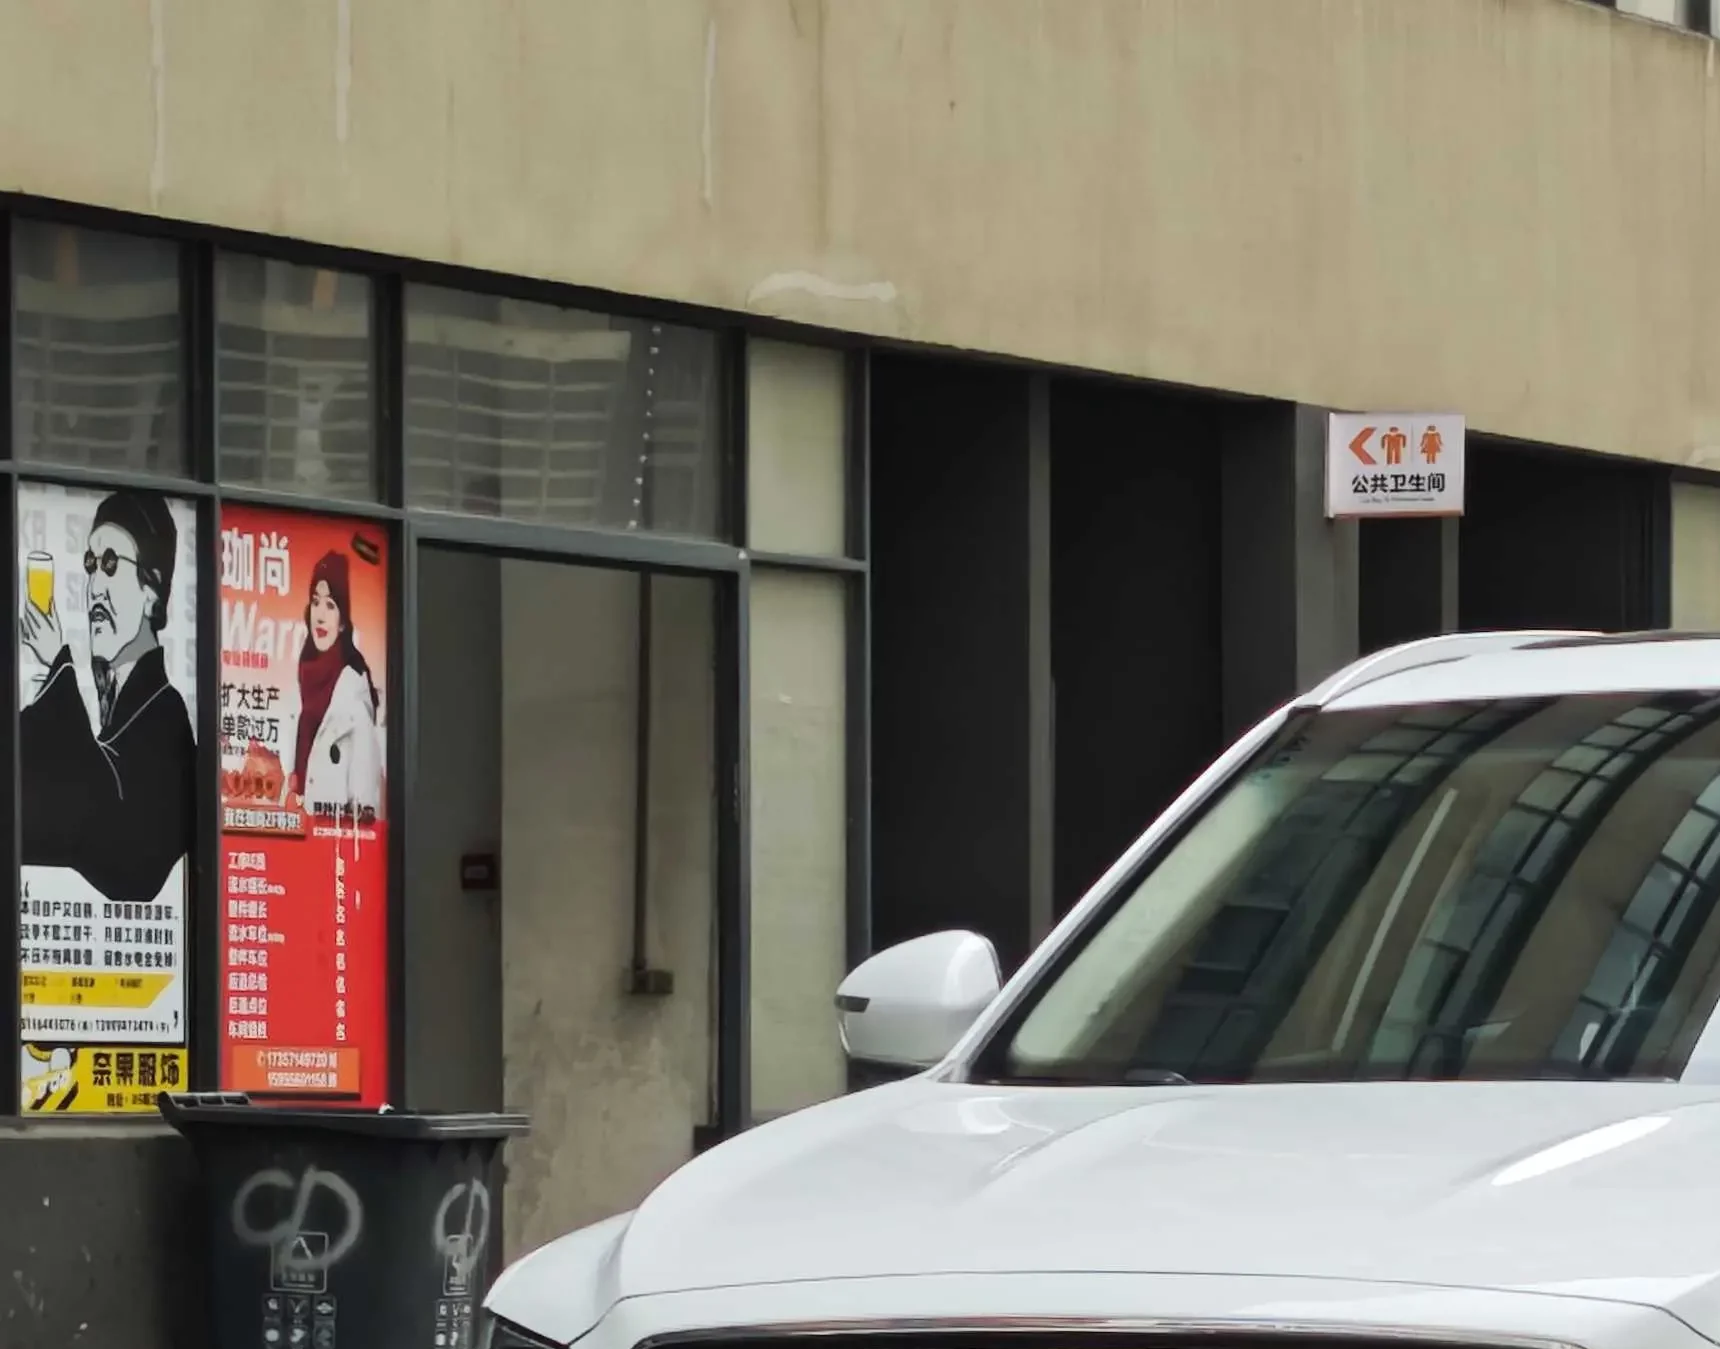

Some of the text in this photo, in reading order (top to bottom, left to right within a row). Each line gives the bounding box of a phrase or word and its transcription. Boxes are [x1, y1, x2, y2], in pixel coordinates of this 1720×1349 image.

[1352, 473, 1446, 494] 公共卫生间
[221, 683, 281, 711] 扩大生产
[222, 713, 281, 744] 单款过万
